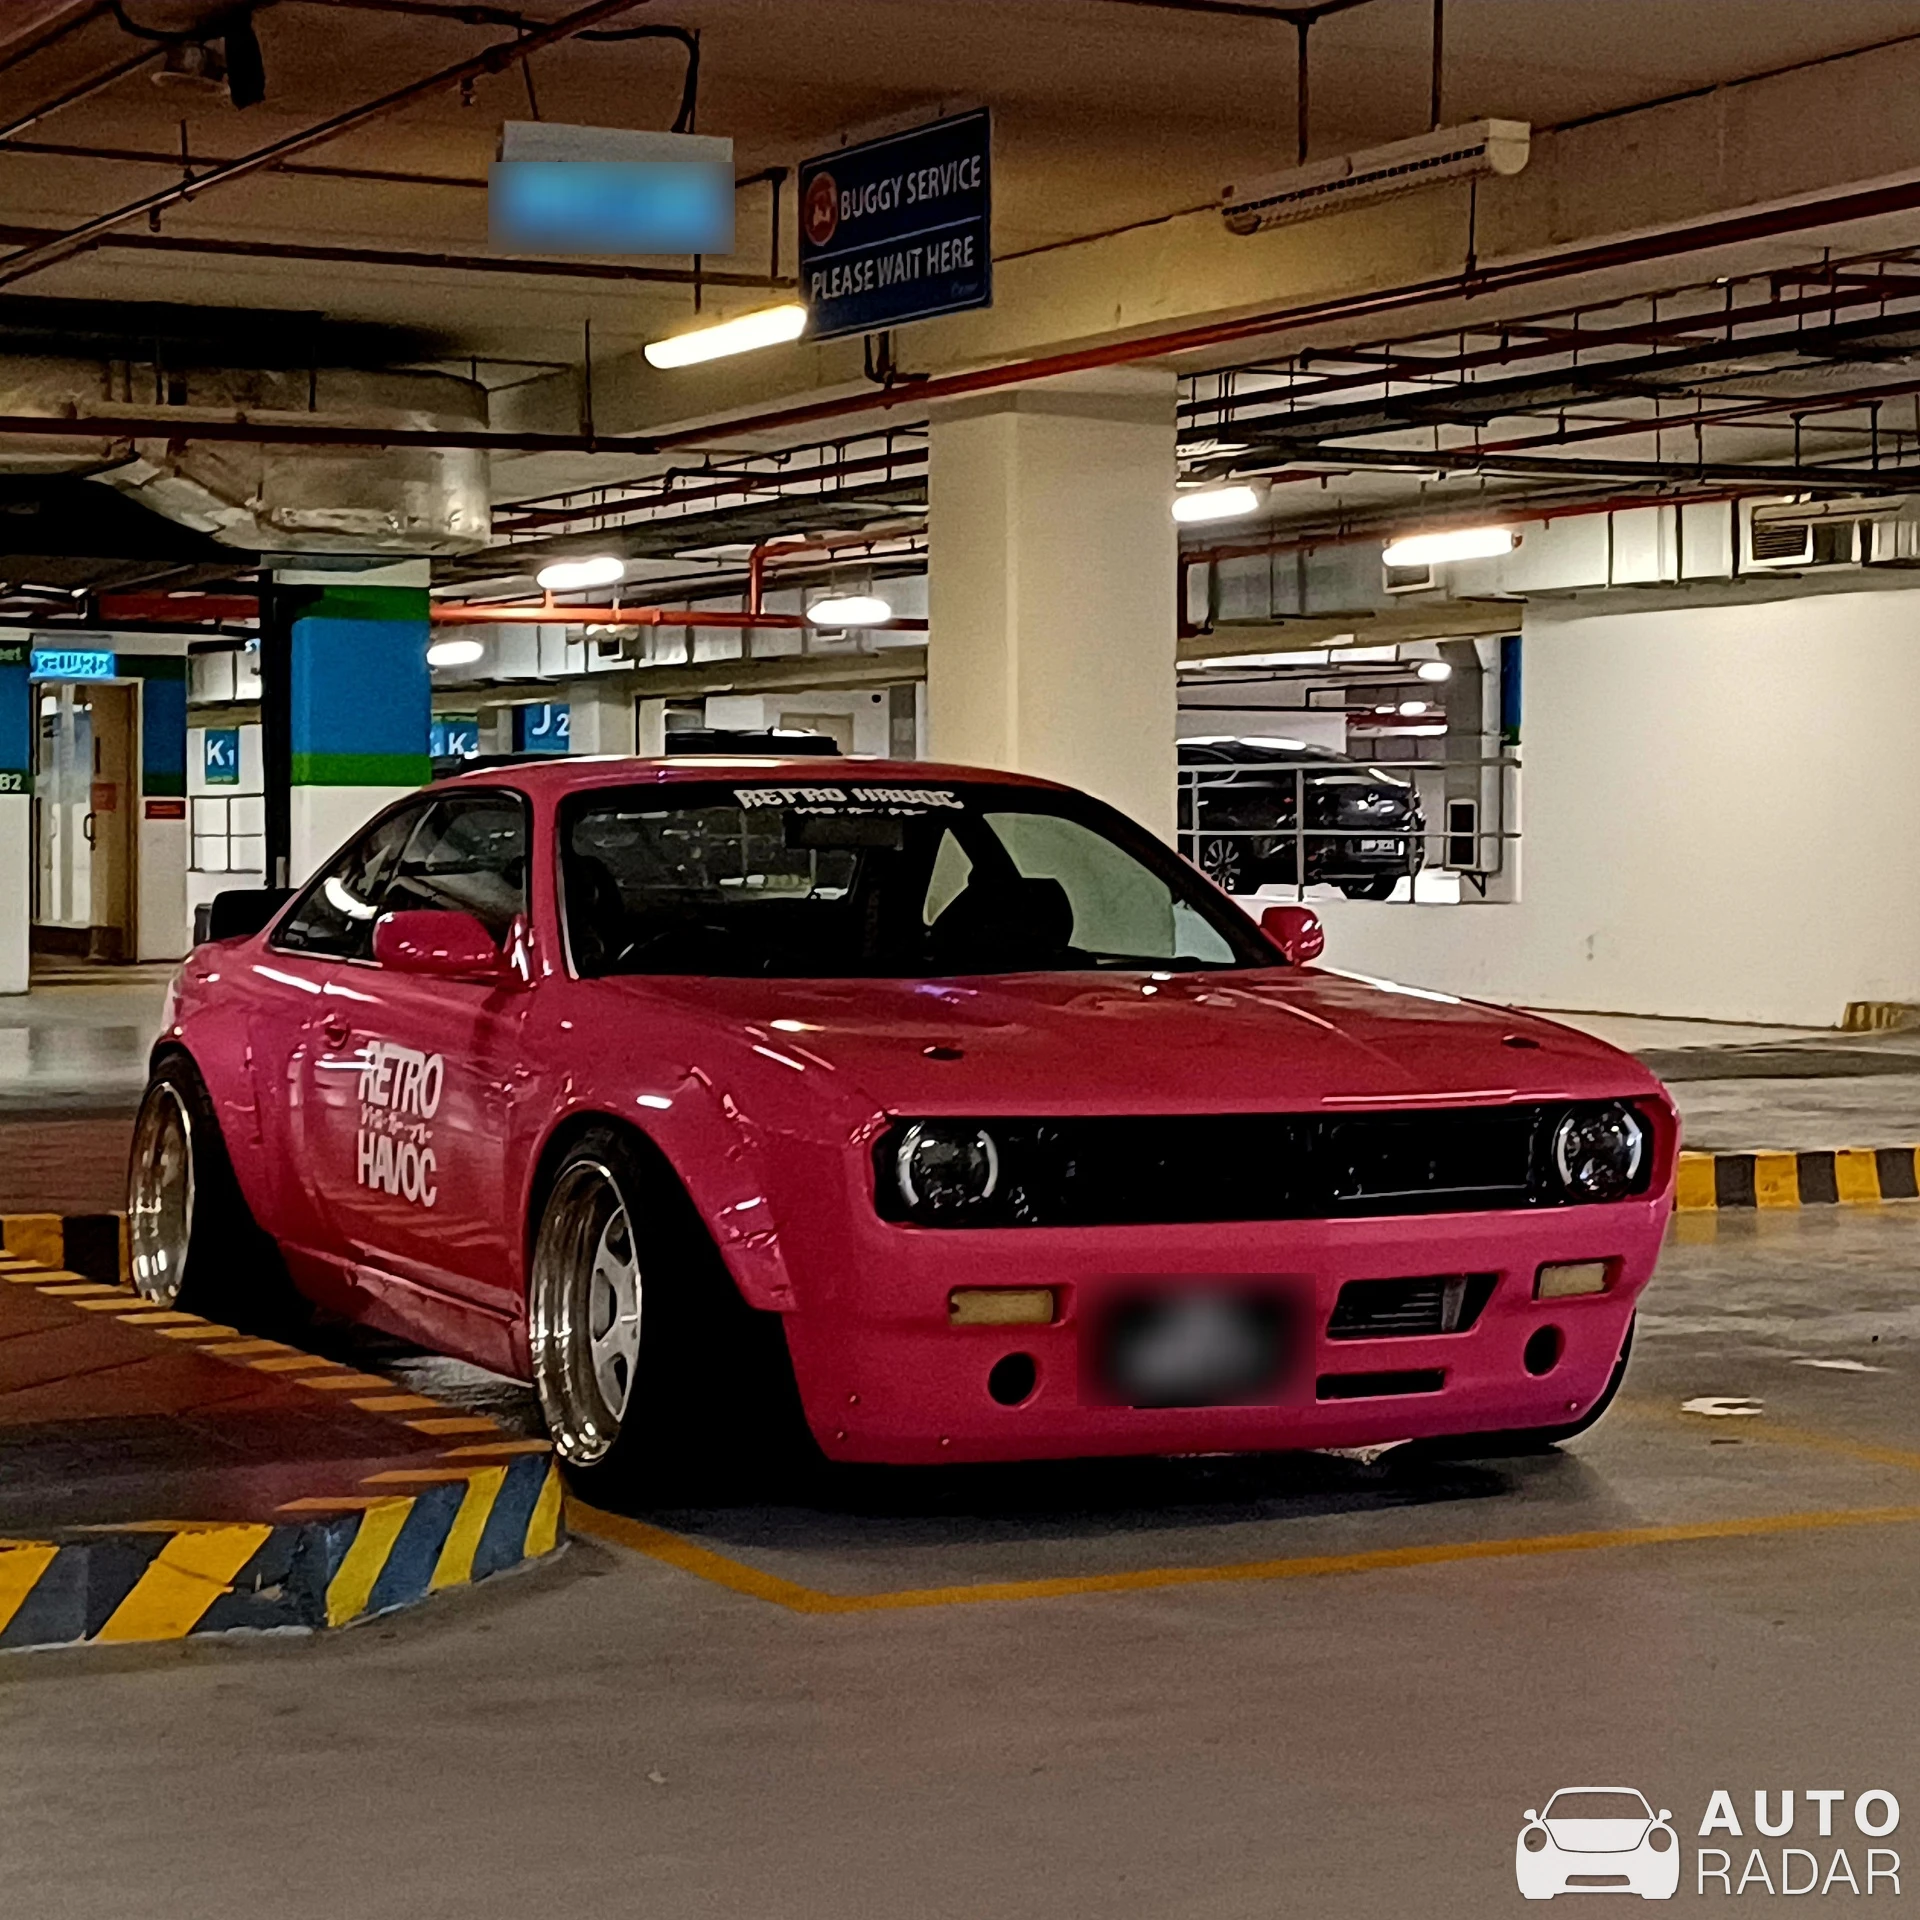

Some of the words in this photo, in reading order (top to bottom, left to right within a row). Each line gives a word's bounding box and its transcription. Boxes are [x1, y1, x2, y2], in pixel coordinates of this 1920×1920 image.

[840, 174, 904, 221] BUGGY
[906, 154, 982, 204] SERVICE
[811, 259, 874, 302] PLEASE
[876, 247, 923, 288] WAIT
[926, 235, 974, 277] HERE
[206, 739, 235, 766] K1
[733, 788, 848, 810] RETRO
[358, 1040, 444, 1120] RETRO
[357, 1128, 438, 1208] HAVOC
